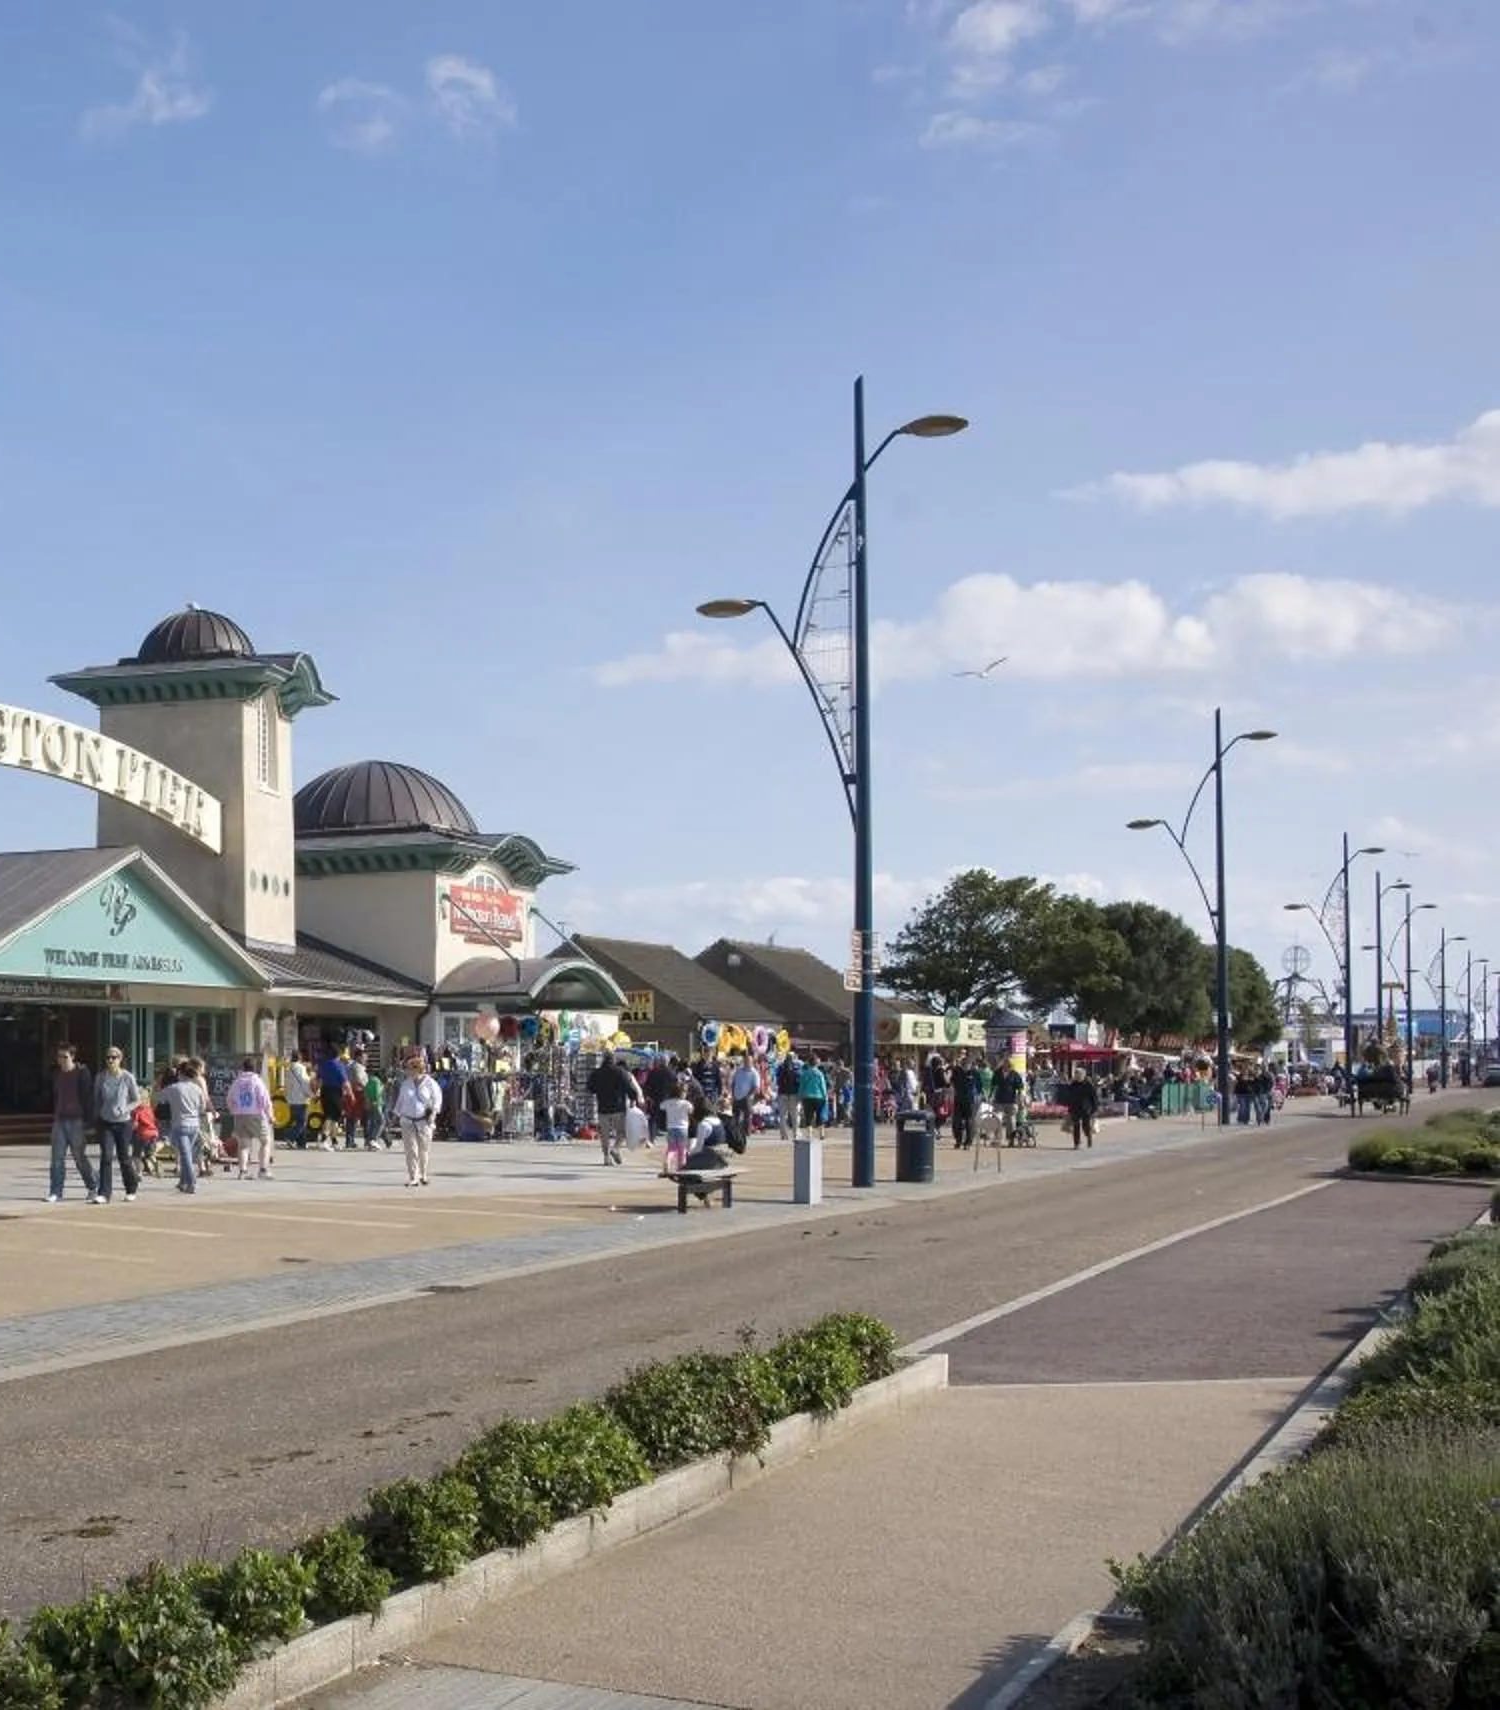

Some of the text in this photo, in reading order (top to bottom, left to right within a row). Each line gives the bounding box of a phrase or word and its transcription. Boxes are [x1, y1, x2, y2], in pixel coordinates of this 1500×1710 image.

[114, 748, 208, 836] PIER
[44, 948, 100, 967] WELCOME
[102, 953, 129, 969] FREE
